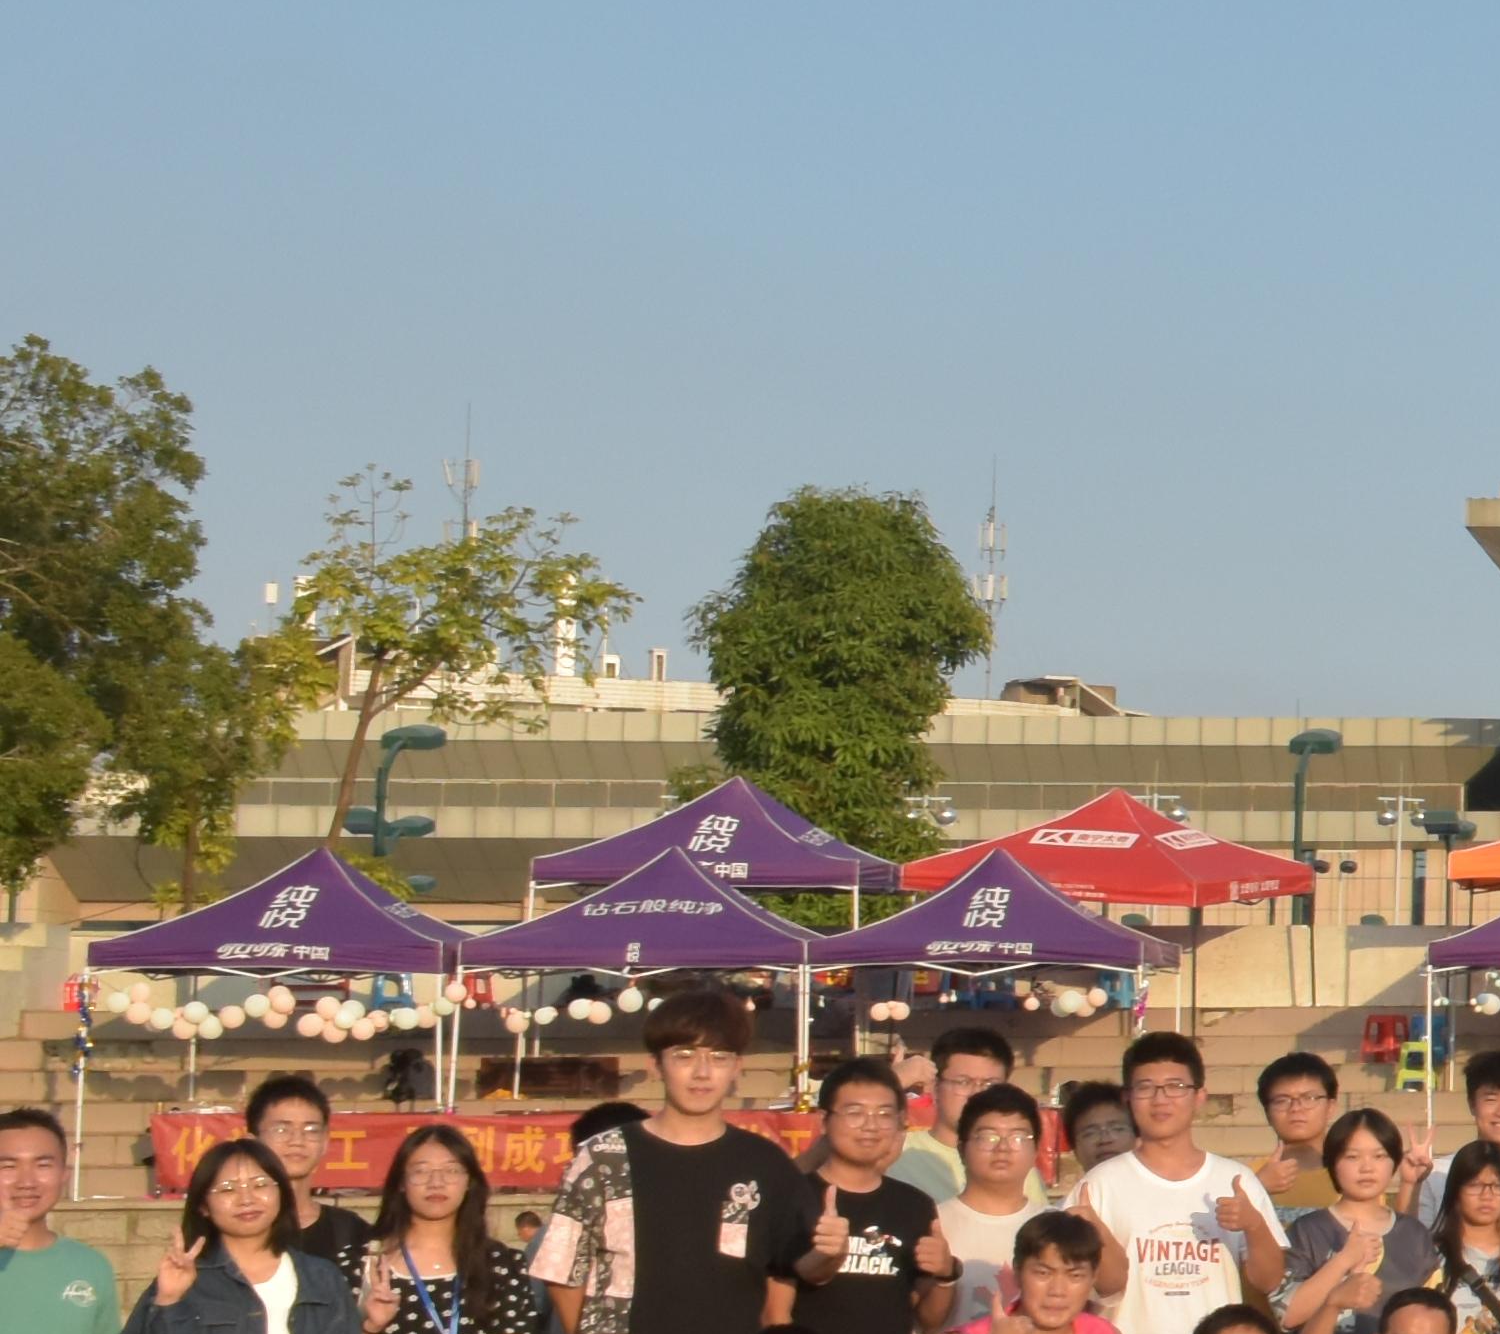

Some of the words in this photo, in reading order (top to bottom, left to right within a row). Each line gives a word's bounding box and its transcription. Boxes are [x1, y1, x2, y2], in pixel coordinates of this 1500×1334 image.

[582, 898, 724, 917] 钻石般纯净
[1135, 1236, 1221, 1264] VINTAGE
[1154, 1262, 1201, 1276] LEAGUE
